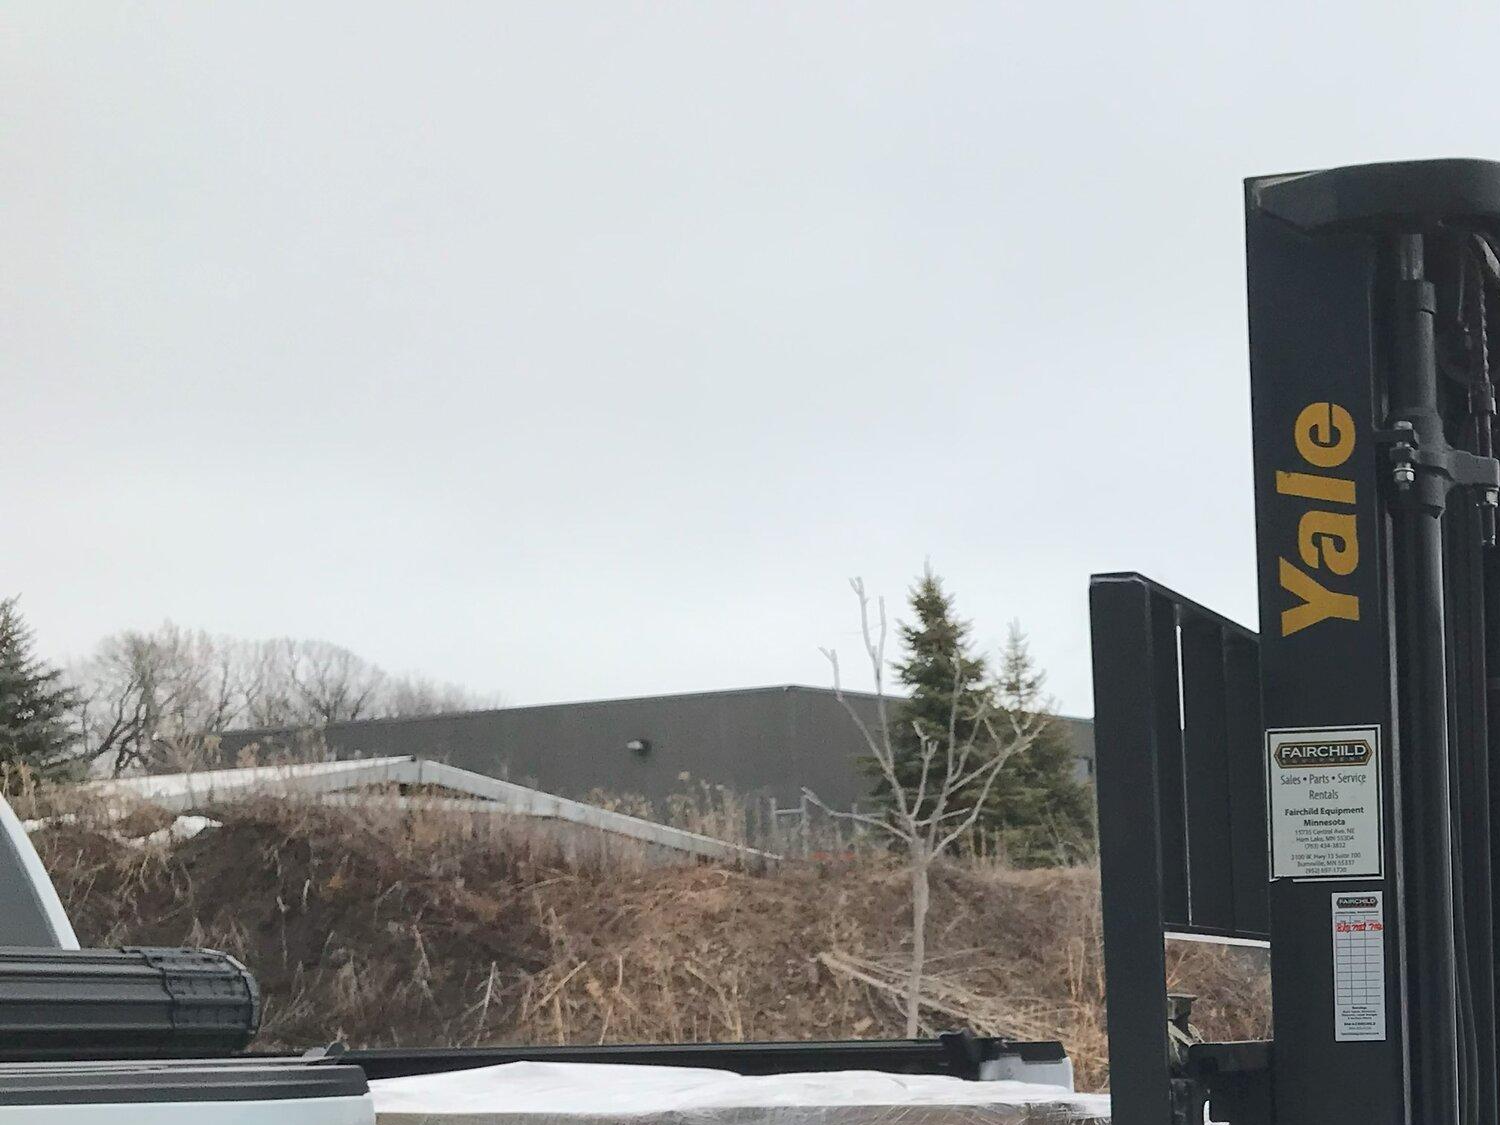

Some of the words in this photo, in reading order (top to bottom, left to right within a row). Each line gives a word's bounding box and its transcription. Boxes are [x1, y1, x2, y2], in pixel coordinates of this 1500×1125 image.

[1275, 402, 1360, 637] Yale
[1281, 745, 1366, 758] FAIRCHILD
[1280, 775, 1301, 785] Sales
[1309, 774, 1330, 784] Parts
[1337, 773, 1366, 783] Service
[1309, 789, 1339, 800] Rentals
[1285, 807, 1319, 816] Fairchild
[1320, 806, 1364, 815] Equipment
